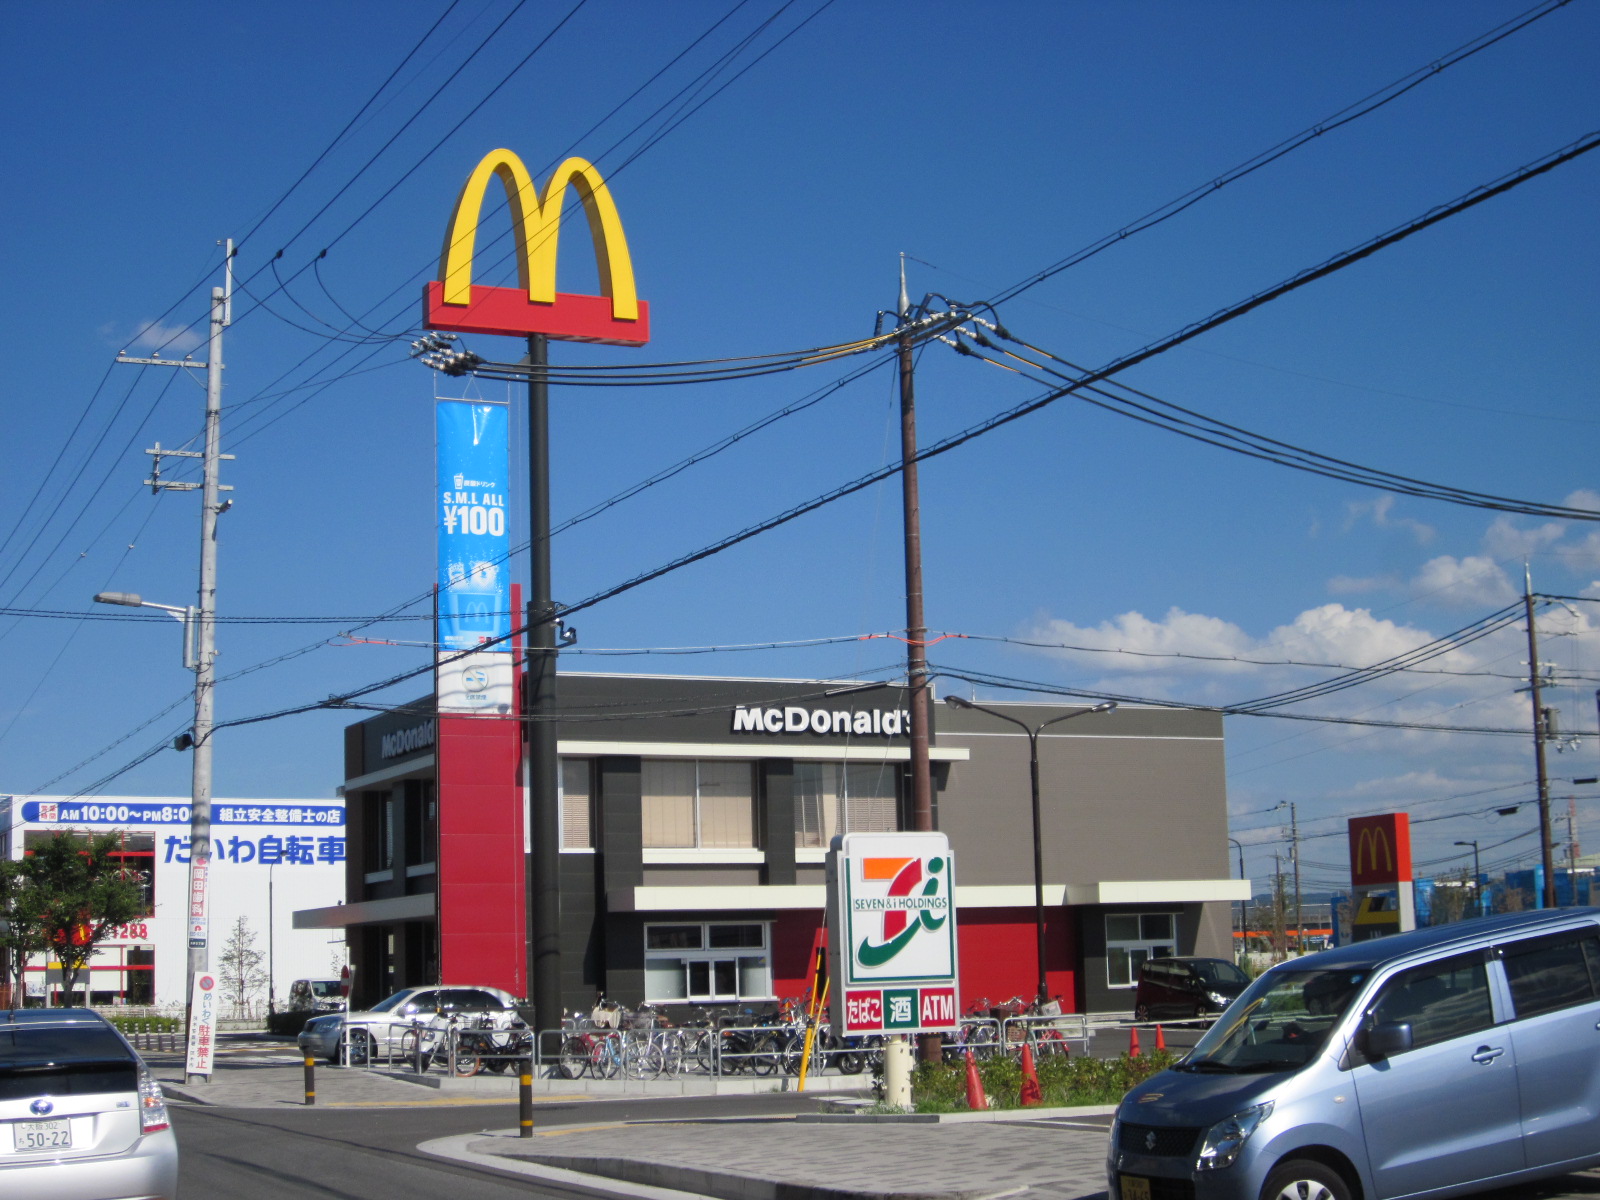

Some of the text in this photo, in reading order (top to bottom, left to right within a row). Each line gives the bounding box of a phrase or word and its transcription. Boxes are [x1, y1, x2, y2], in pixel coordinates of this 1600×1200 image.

[482, 493, 505, 507] ALL
[443, 505, 505, 537] ¥100
[219, 807, 341, 824] 組立安全整備士の店
[899, 897, 948, 909] HOLDINGS
[847, 998, 882, 1024] たばこ
[890, 996, 912, 1022] 酒
[922, 995, 954, 1020] ATM
[27, 1131, 70, 1148] 50-22
